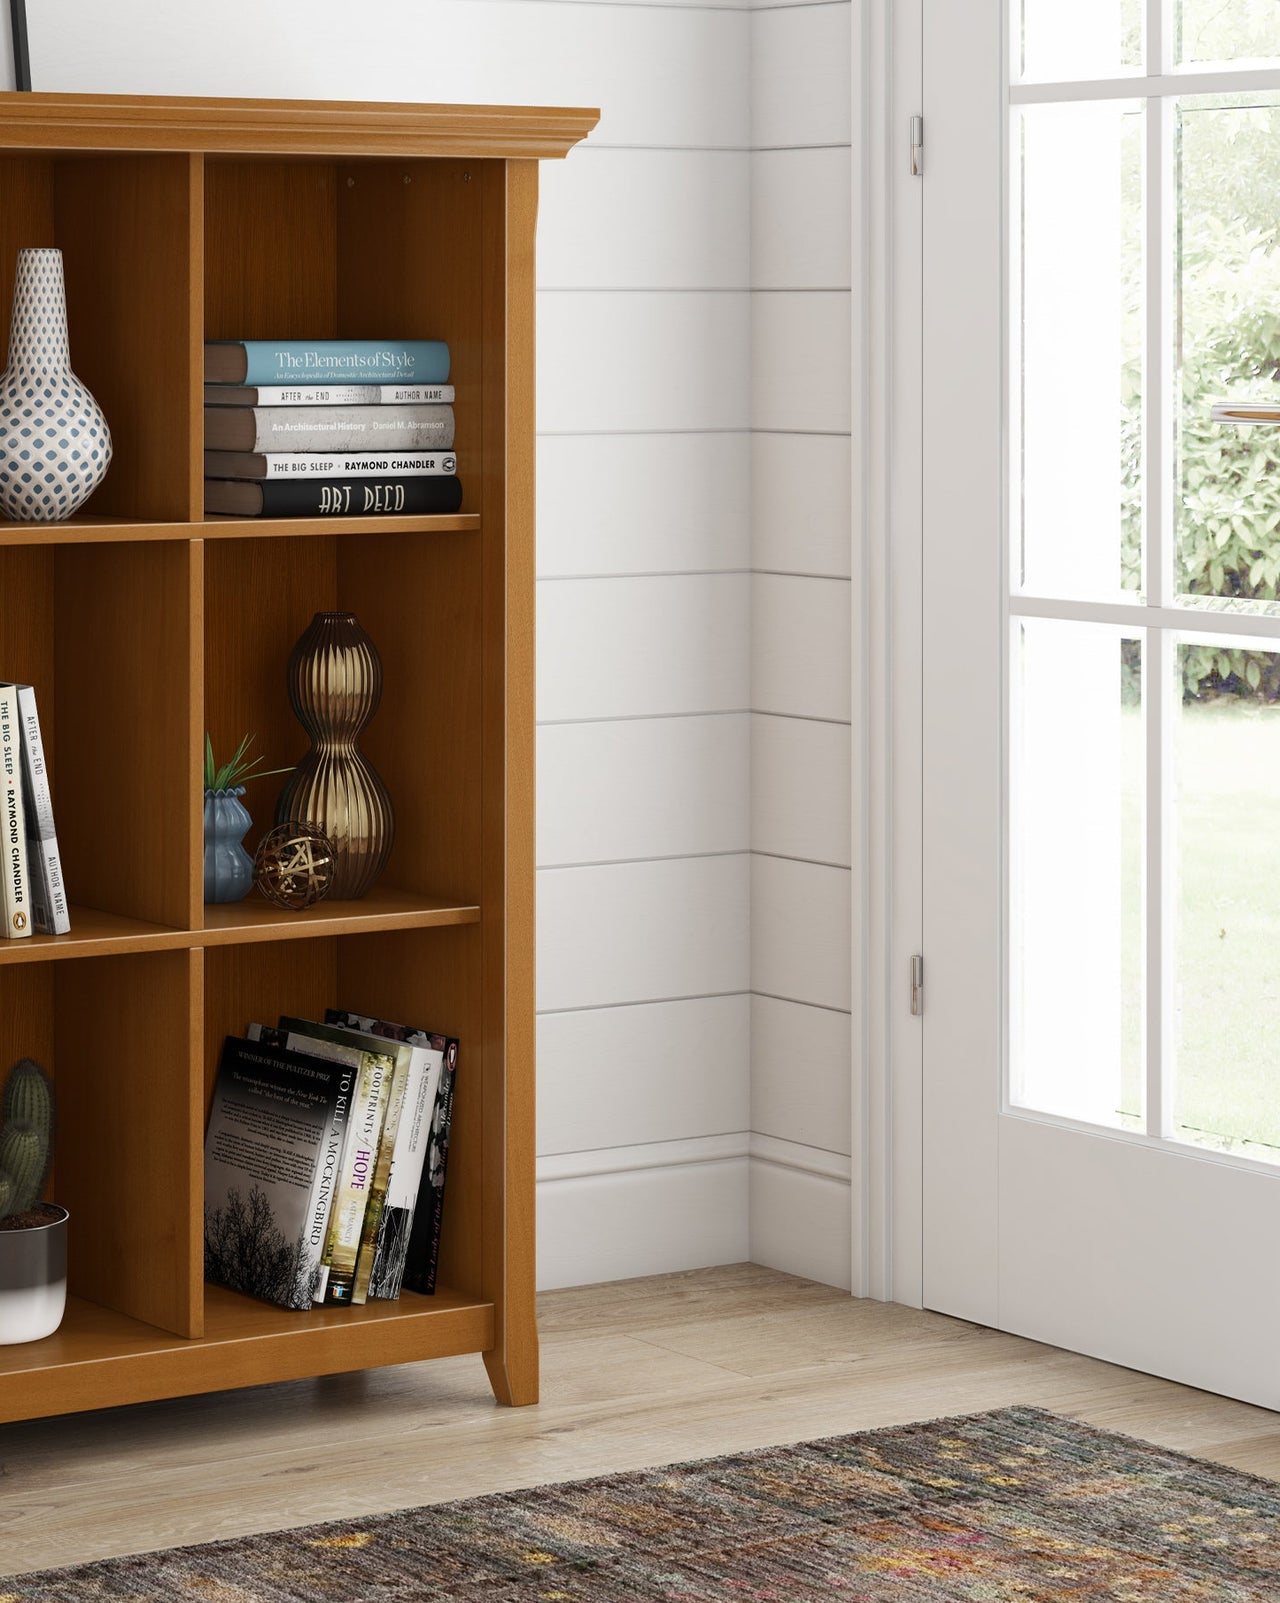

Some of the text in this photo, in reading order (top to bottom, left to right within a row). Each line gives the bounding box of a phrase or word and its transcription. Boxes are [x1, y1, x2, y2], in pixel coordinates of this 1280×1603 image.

[274, 351, 415, 370] The Elements of Style
[281, 391, 302, 401] AFTER
[305, 393, 314, 401] the
[316, 391, 330, 401] END
[395, 390, 421, 400] AUTHOR
[424, 390, 443, 400] NAME
[272, 420, 445, 432] An Architectural History Daniel M. Abramson
[273, 460, 436, 472] THE BIG SLEEP RAYMOND CHANDLER
[318, 485, 405, 513] ART DECO
[27, 716, 38, 741] AFTER
[33, 758, 44, 775] END
[0, 701, 23, 903] THE BIG SLEEP RAYMOND CHANDLER
[48, 856, 61, 888] AUTHOR
[54, 892, 65, 916] NAME
[363, 1066, 384, 1133] FOOTPRINTS
[311, 1071, 352, 1245] TO KILL A MOCKINGBIRD
[350, 1150, 370, 1190] HOPE
